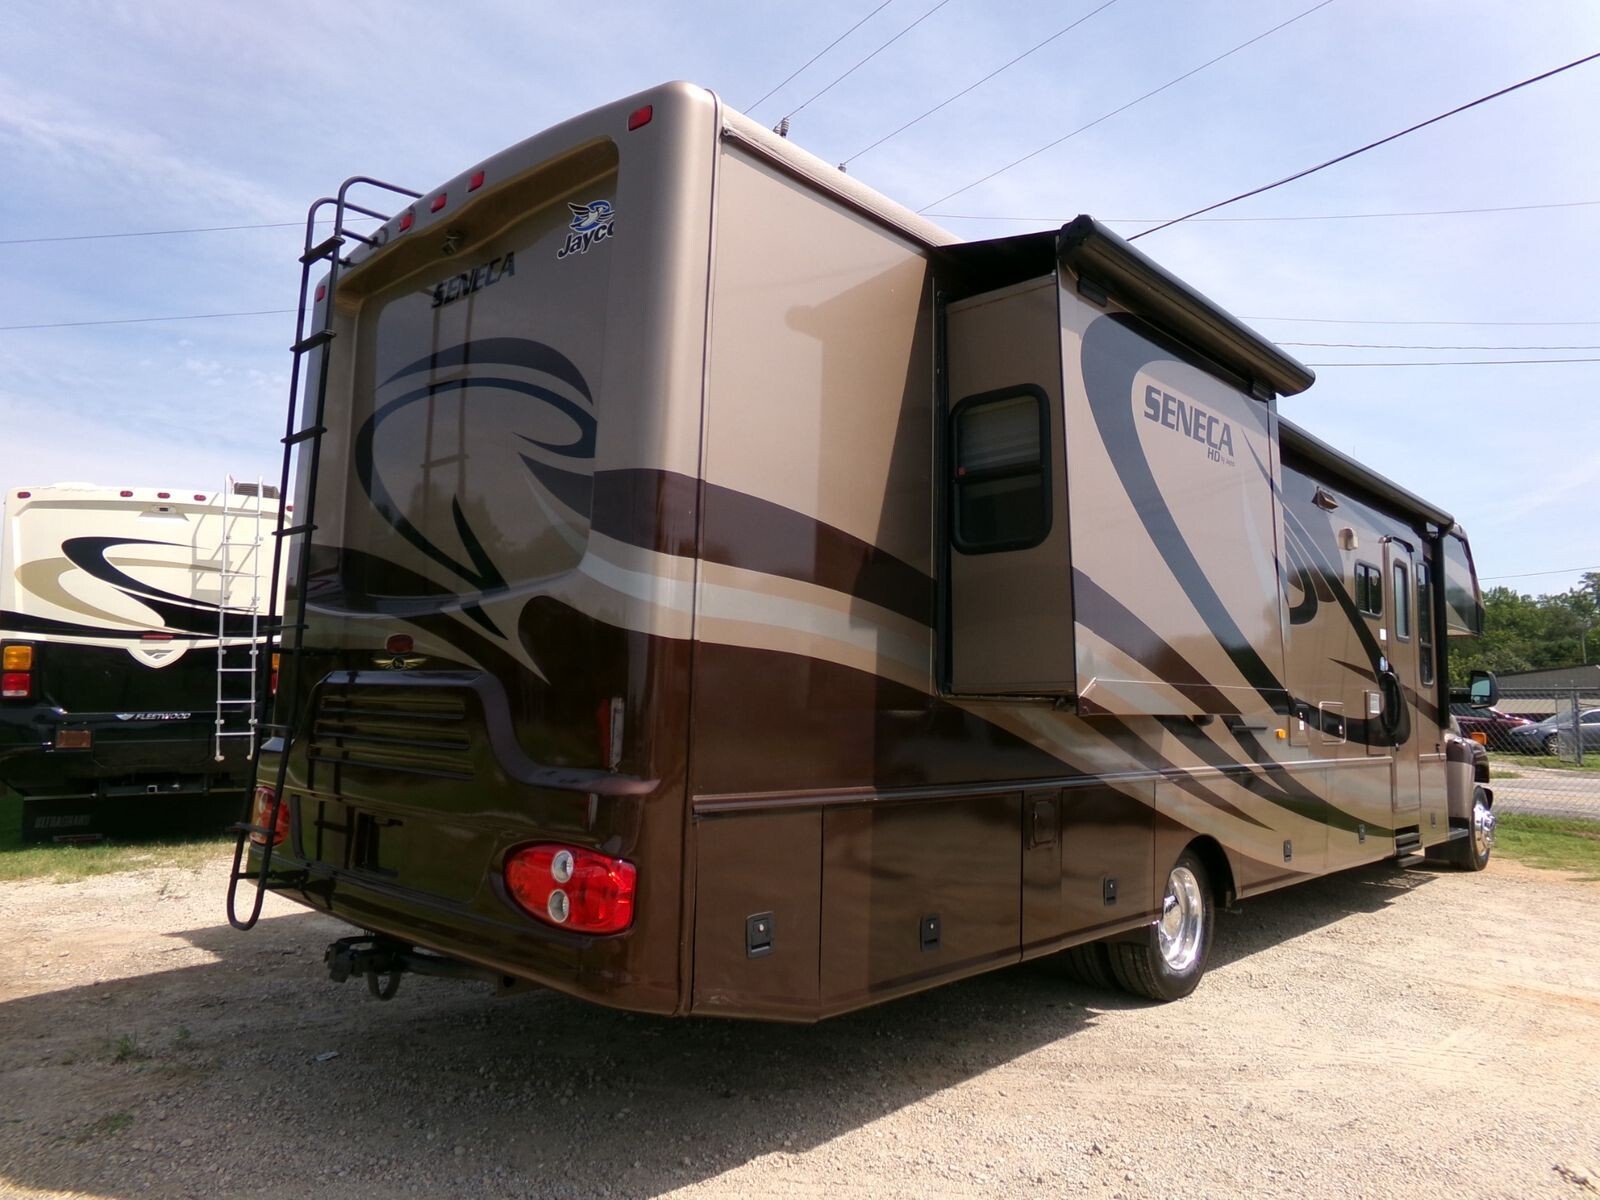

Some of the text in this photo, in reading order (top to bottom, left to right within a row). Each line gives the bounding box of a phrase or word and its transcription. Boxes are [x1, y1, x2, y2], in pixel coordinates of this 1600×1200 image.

[431, 251, 515, 309] SENECA
[1144, 385, 1234, 457] SENECA
[1207, 447, 1220, 462] HD
[135, 712, 191, 720] FLEETWOOD
